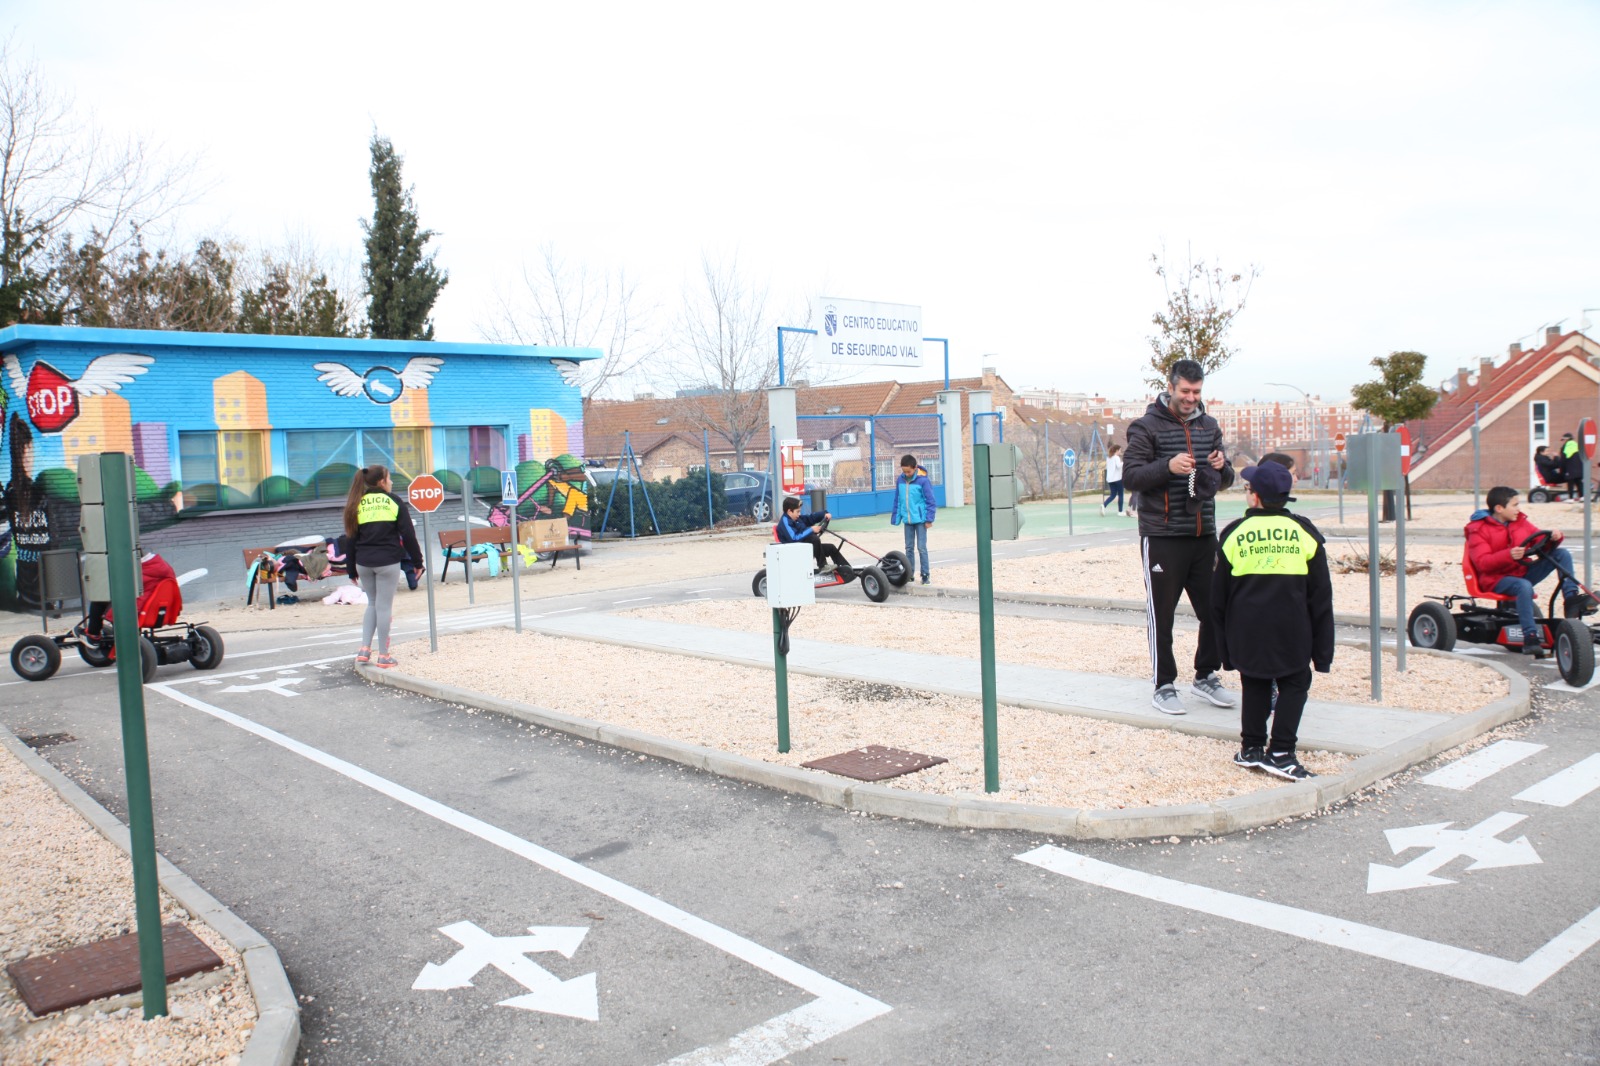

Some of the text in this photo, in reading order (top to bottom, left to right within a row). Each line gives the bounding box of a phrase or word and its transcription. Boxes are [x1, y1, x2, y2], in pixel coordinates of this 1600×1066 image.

[843, 315, 918, 332] CENTRO EDUCATIVO
[831, 342, 918, 358] DE SEGURIDAD VIAL
[28, 386, 72, 418] STOP
[360, 496, 391, 506] OLICIA
[411, 488, 442, 499] STOP
[1236, 528, 1299, 547] POLICIA
[1239, 544, 1300, 558] de Fuenlabrada
